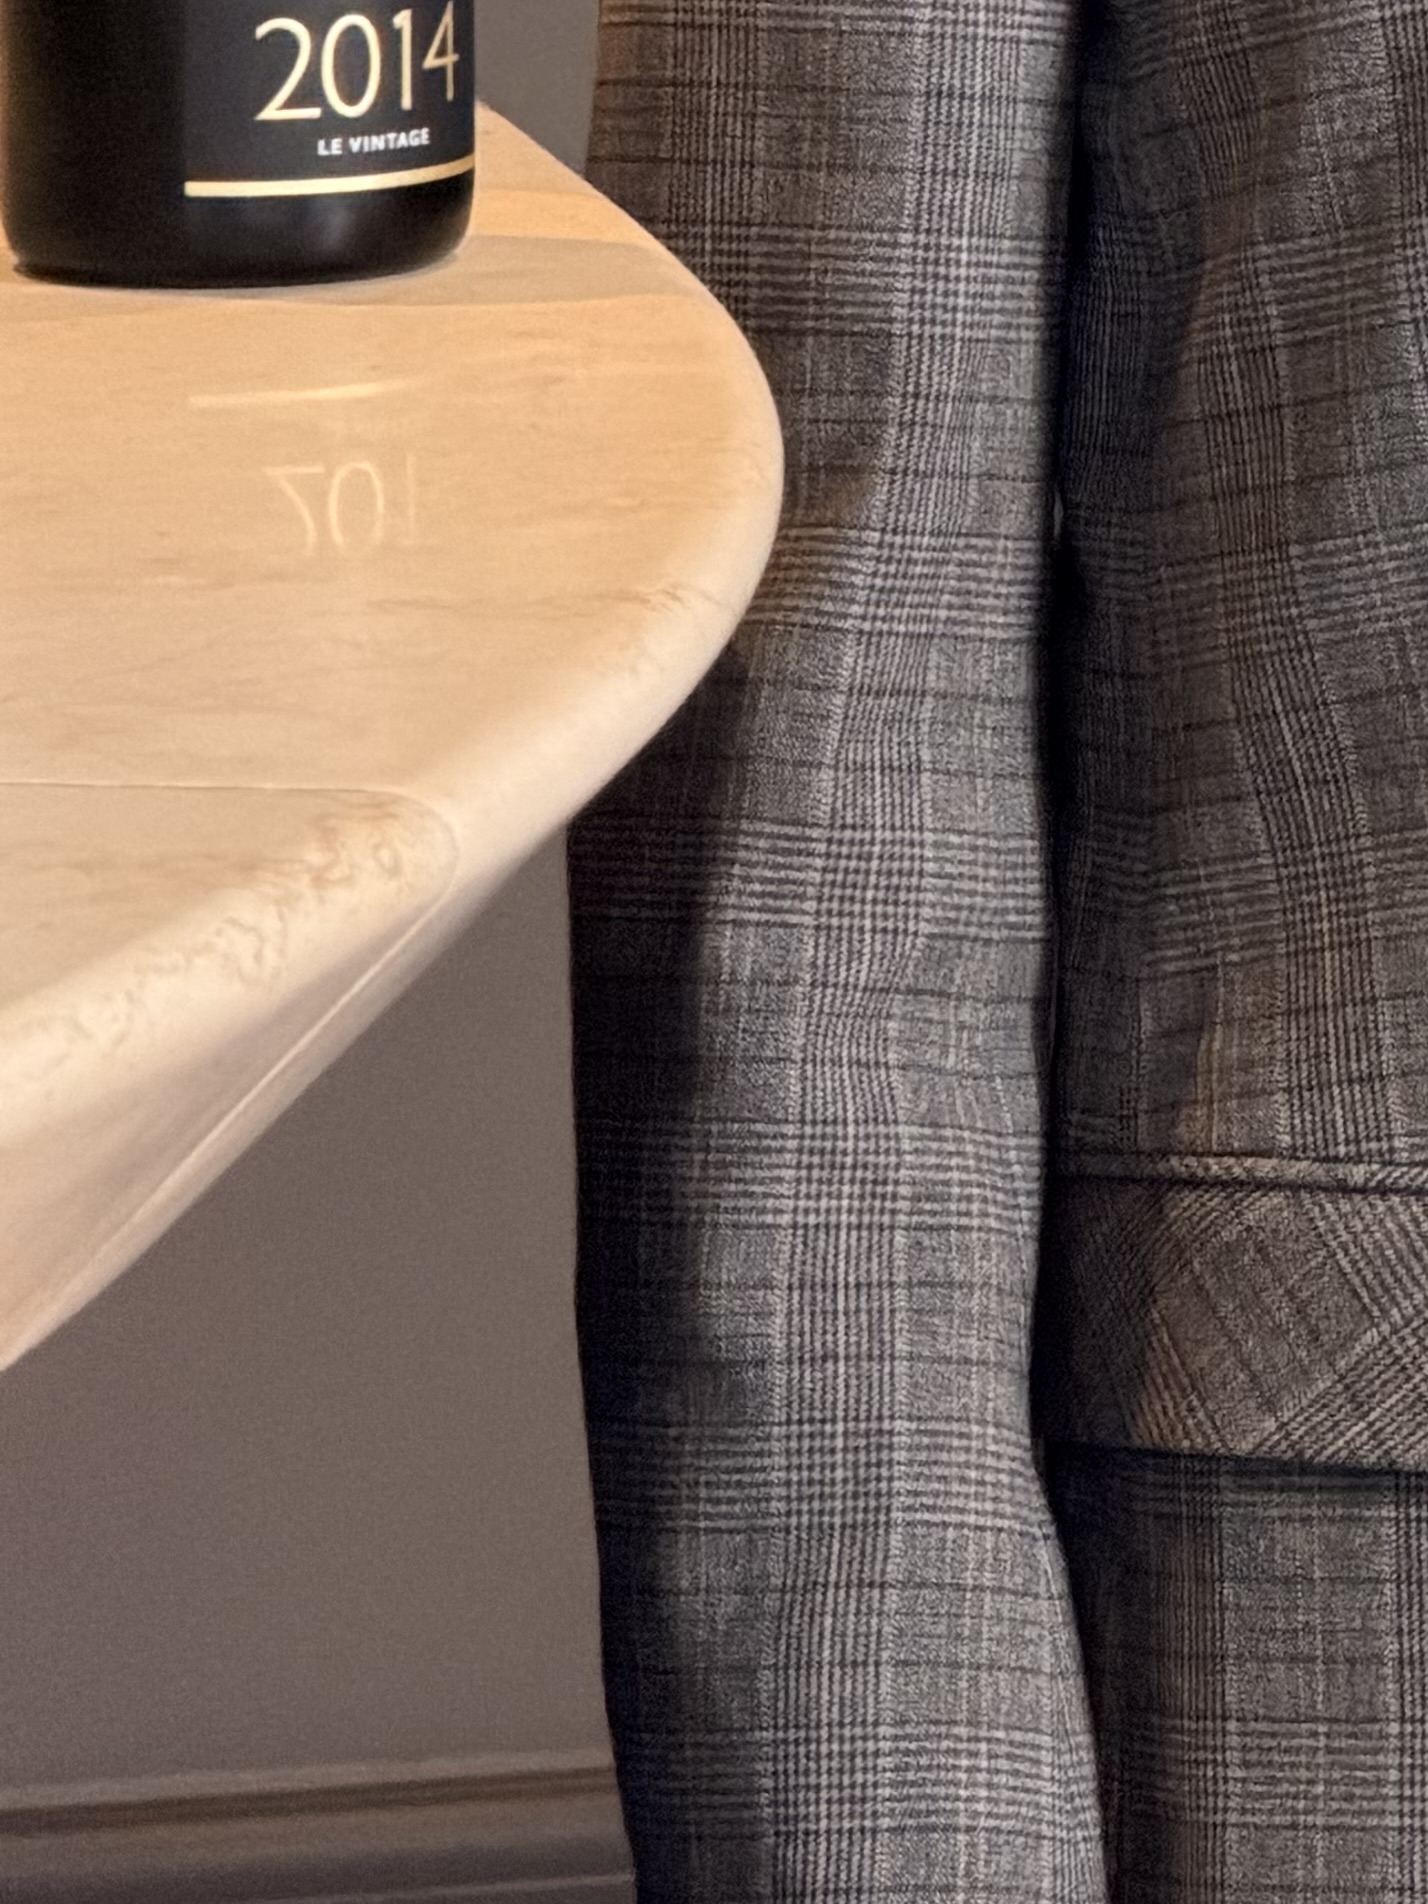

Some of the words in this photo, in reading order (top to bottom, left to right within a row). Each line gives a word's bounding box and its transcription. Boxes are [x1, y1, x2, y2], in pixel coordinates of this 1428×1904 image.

[254, 0, 460, 121] 2014
[317, 138, 343, 156] LE
[349, 127, 431, 153] VINTAGE
